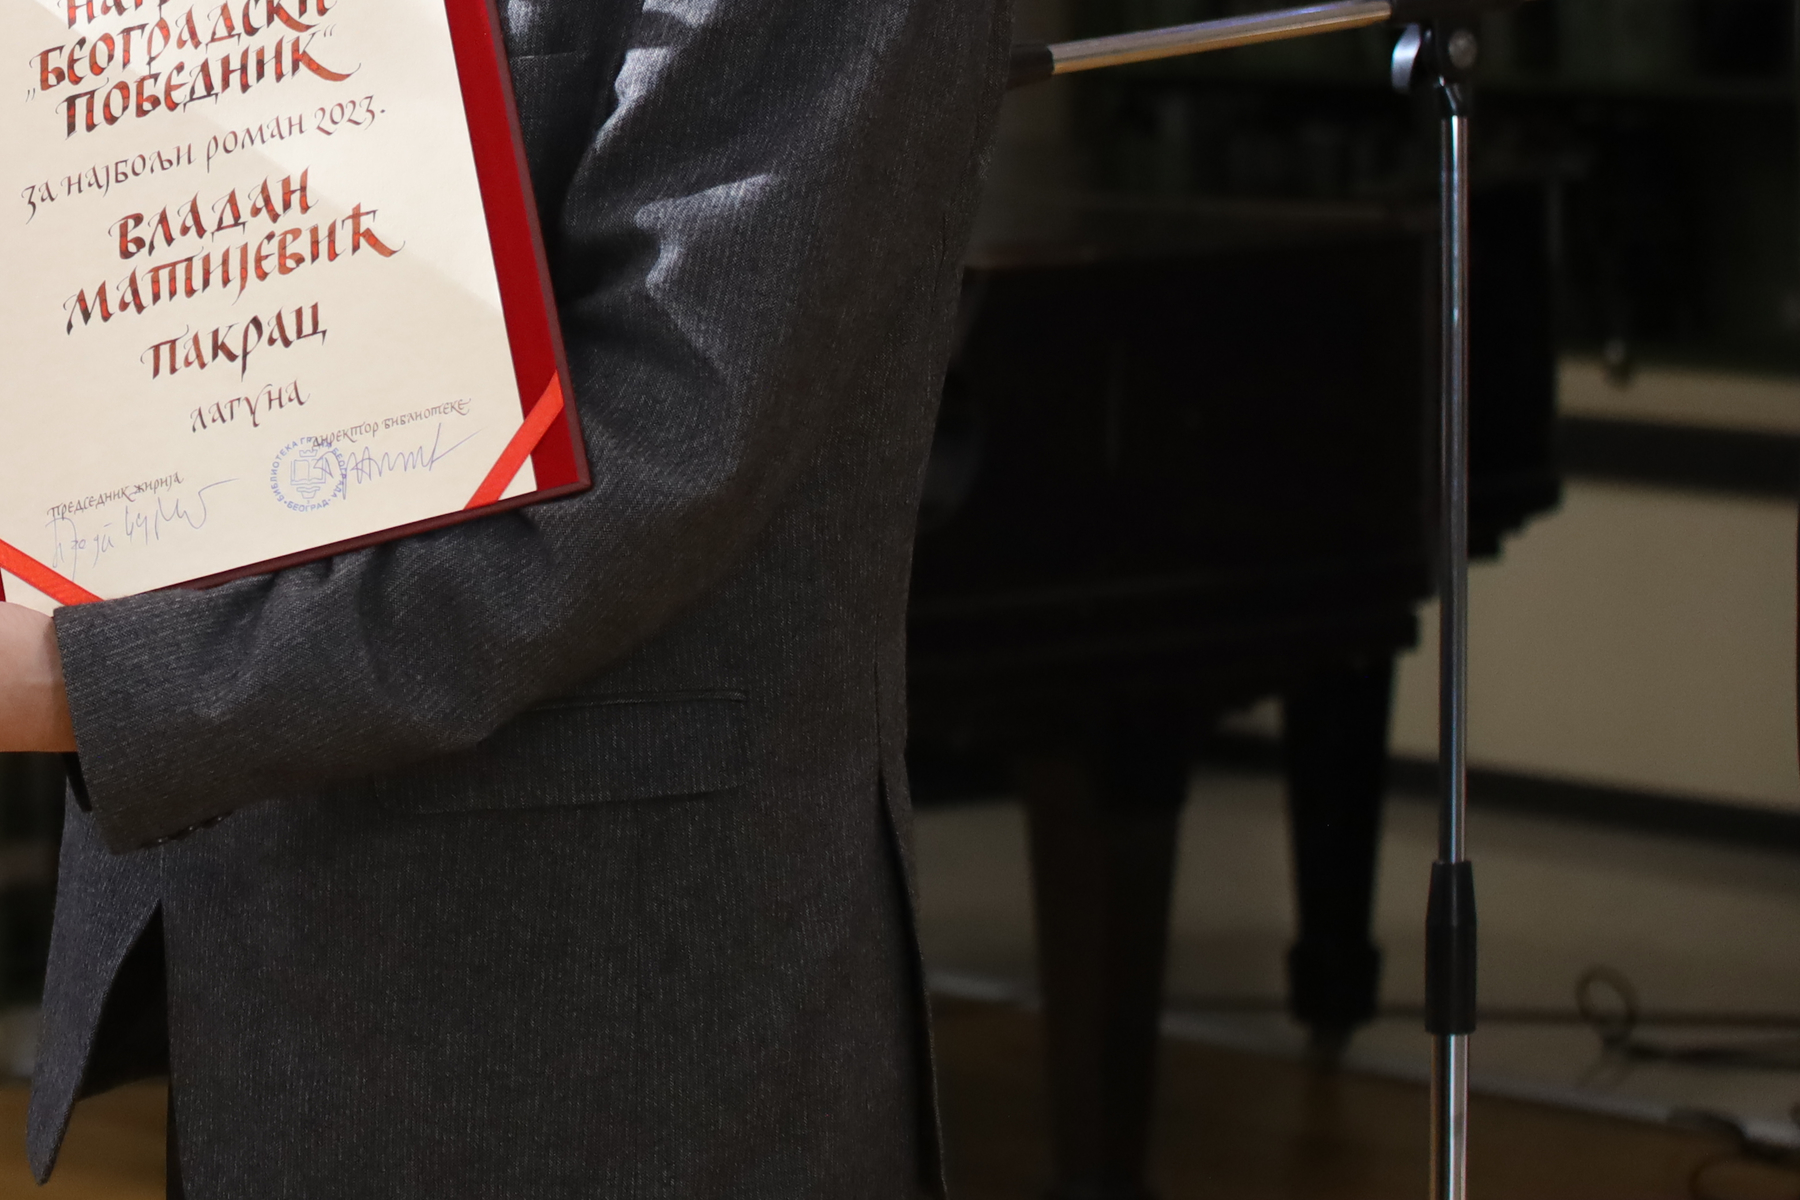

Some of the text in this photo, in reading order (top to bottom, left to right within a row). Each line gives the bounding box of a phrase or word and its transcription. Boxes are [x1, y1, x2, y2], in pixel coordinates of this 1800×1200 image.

[206, 114, 308, 174] РОМАН
[314, 95, 387, 137] 2023.
[108, 167, 319, 260] ВЛАДАН
[63, 202, 406, 336] МАТИЈЕВИЋ
[140, 301, 328, 383] ПАКРАЦ
[190, 378, 311, 433] ЛАГУНА
